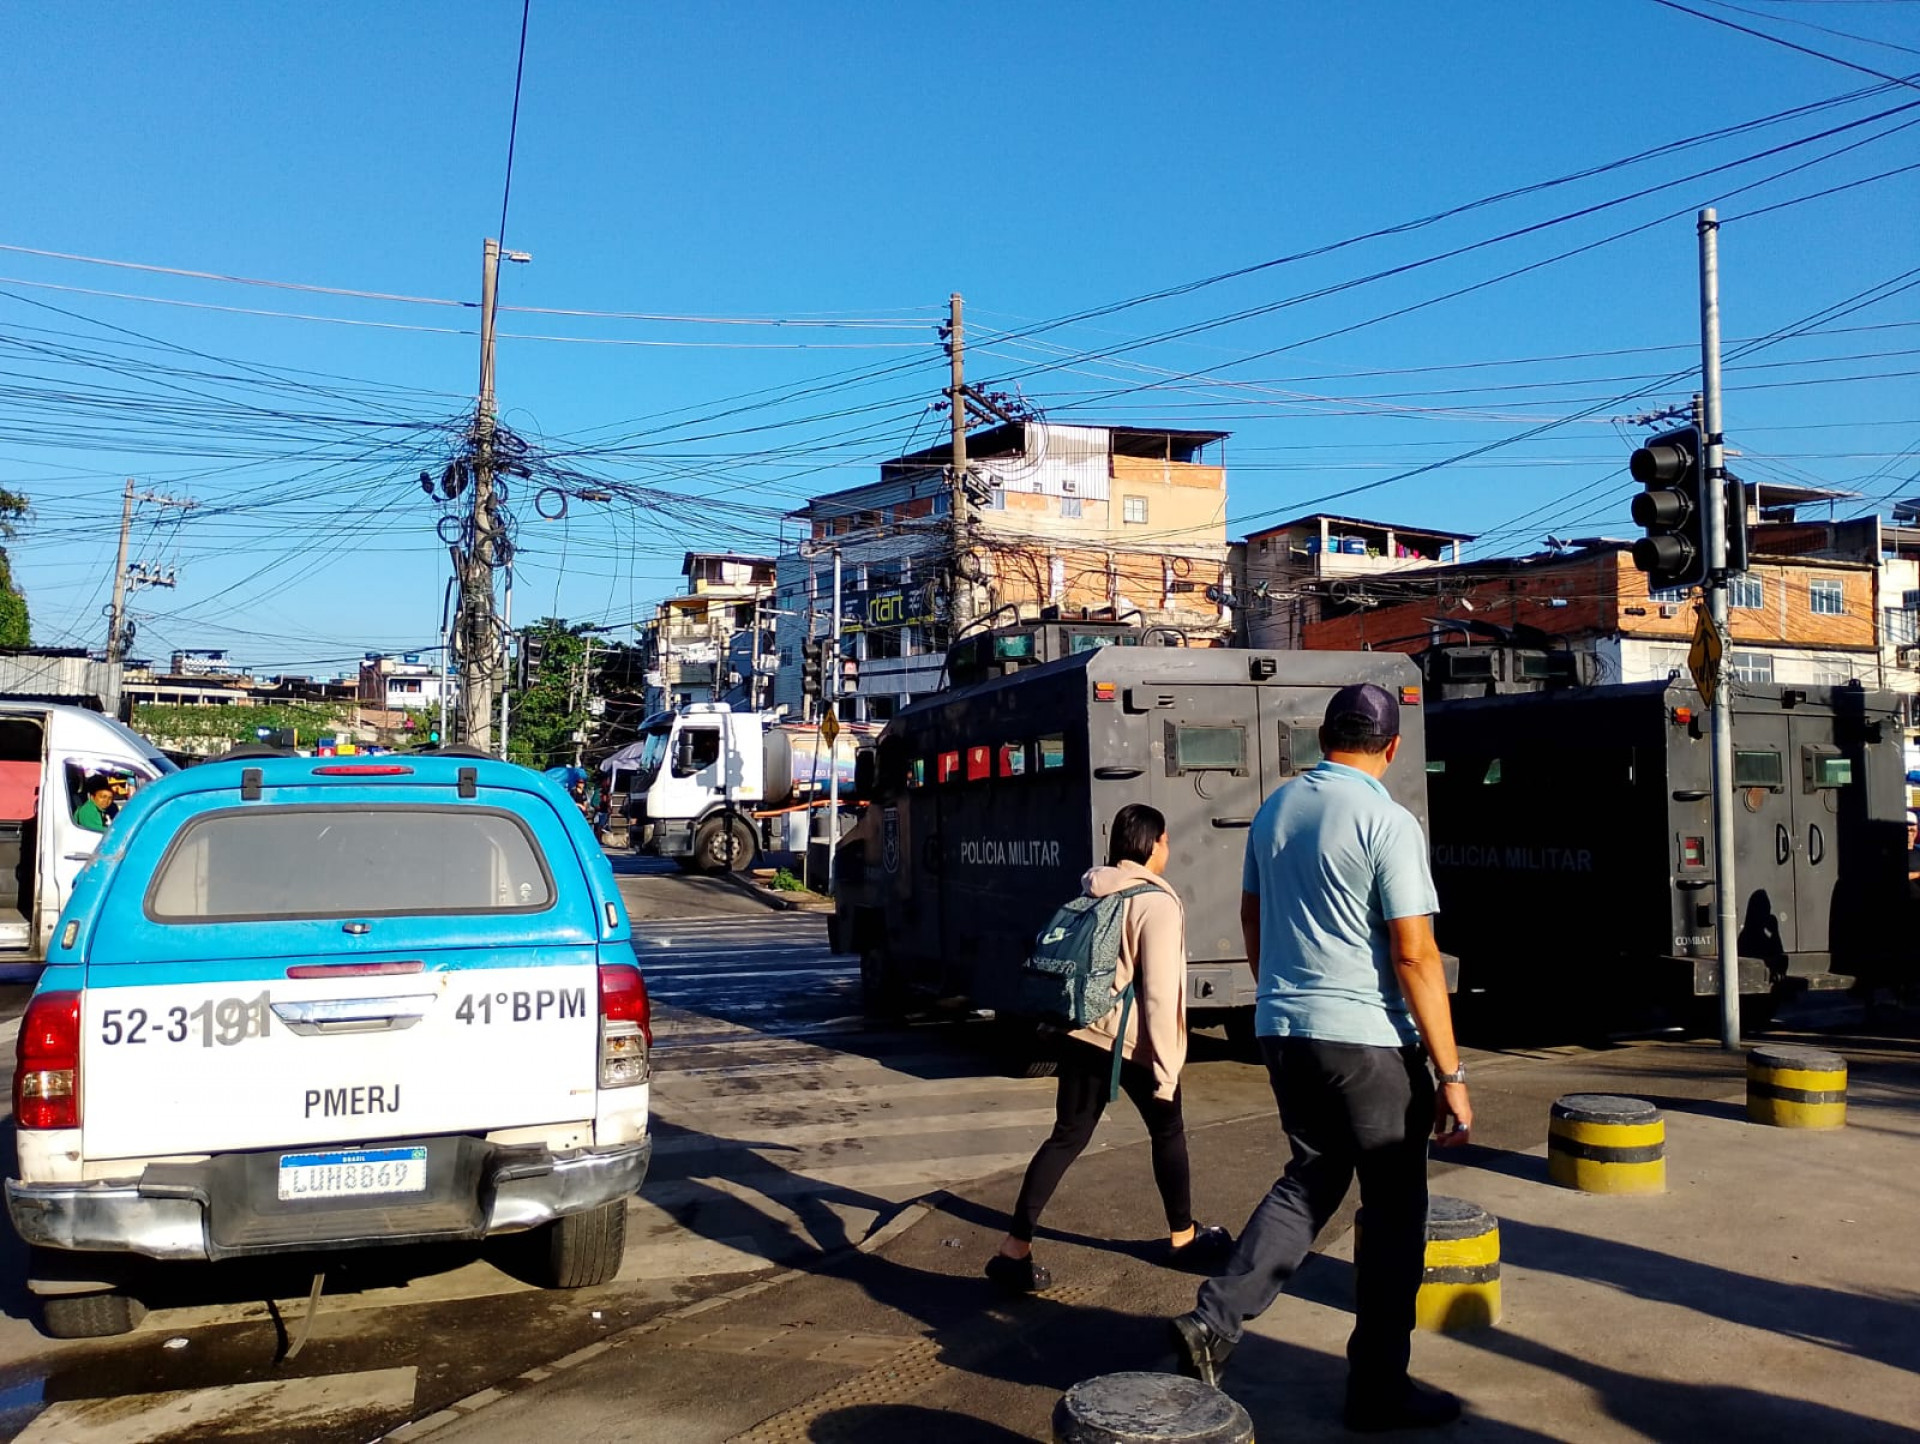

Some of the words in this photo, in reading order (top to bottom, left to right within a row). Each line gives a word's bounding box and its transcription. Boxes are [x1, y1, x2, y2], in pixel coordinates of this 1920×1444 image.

[960, 836, 1007, 865] POLÍCIA
[1008, 840, 1061, 867] MILITAR
[1504, 847, 1593, 873] MILITAR
[1675, 935, 1711, 946] COMBAT
[304, 1083, 401, 1119] PMERJ
[293, 1160, 409, 1193] LUH8869
